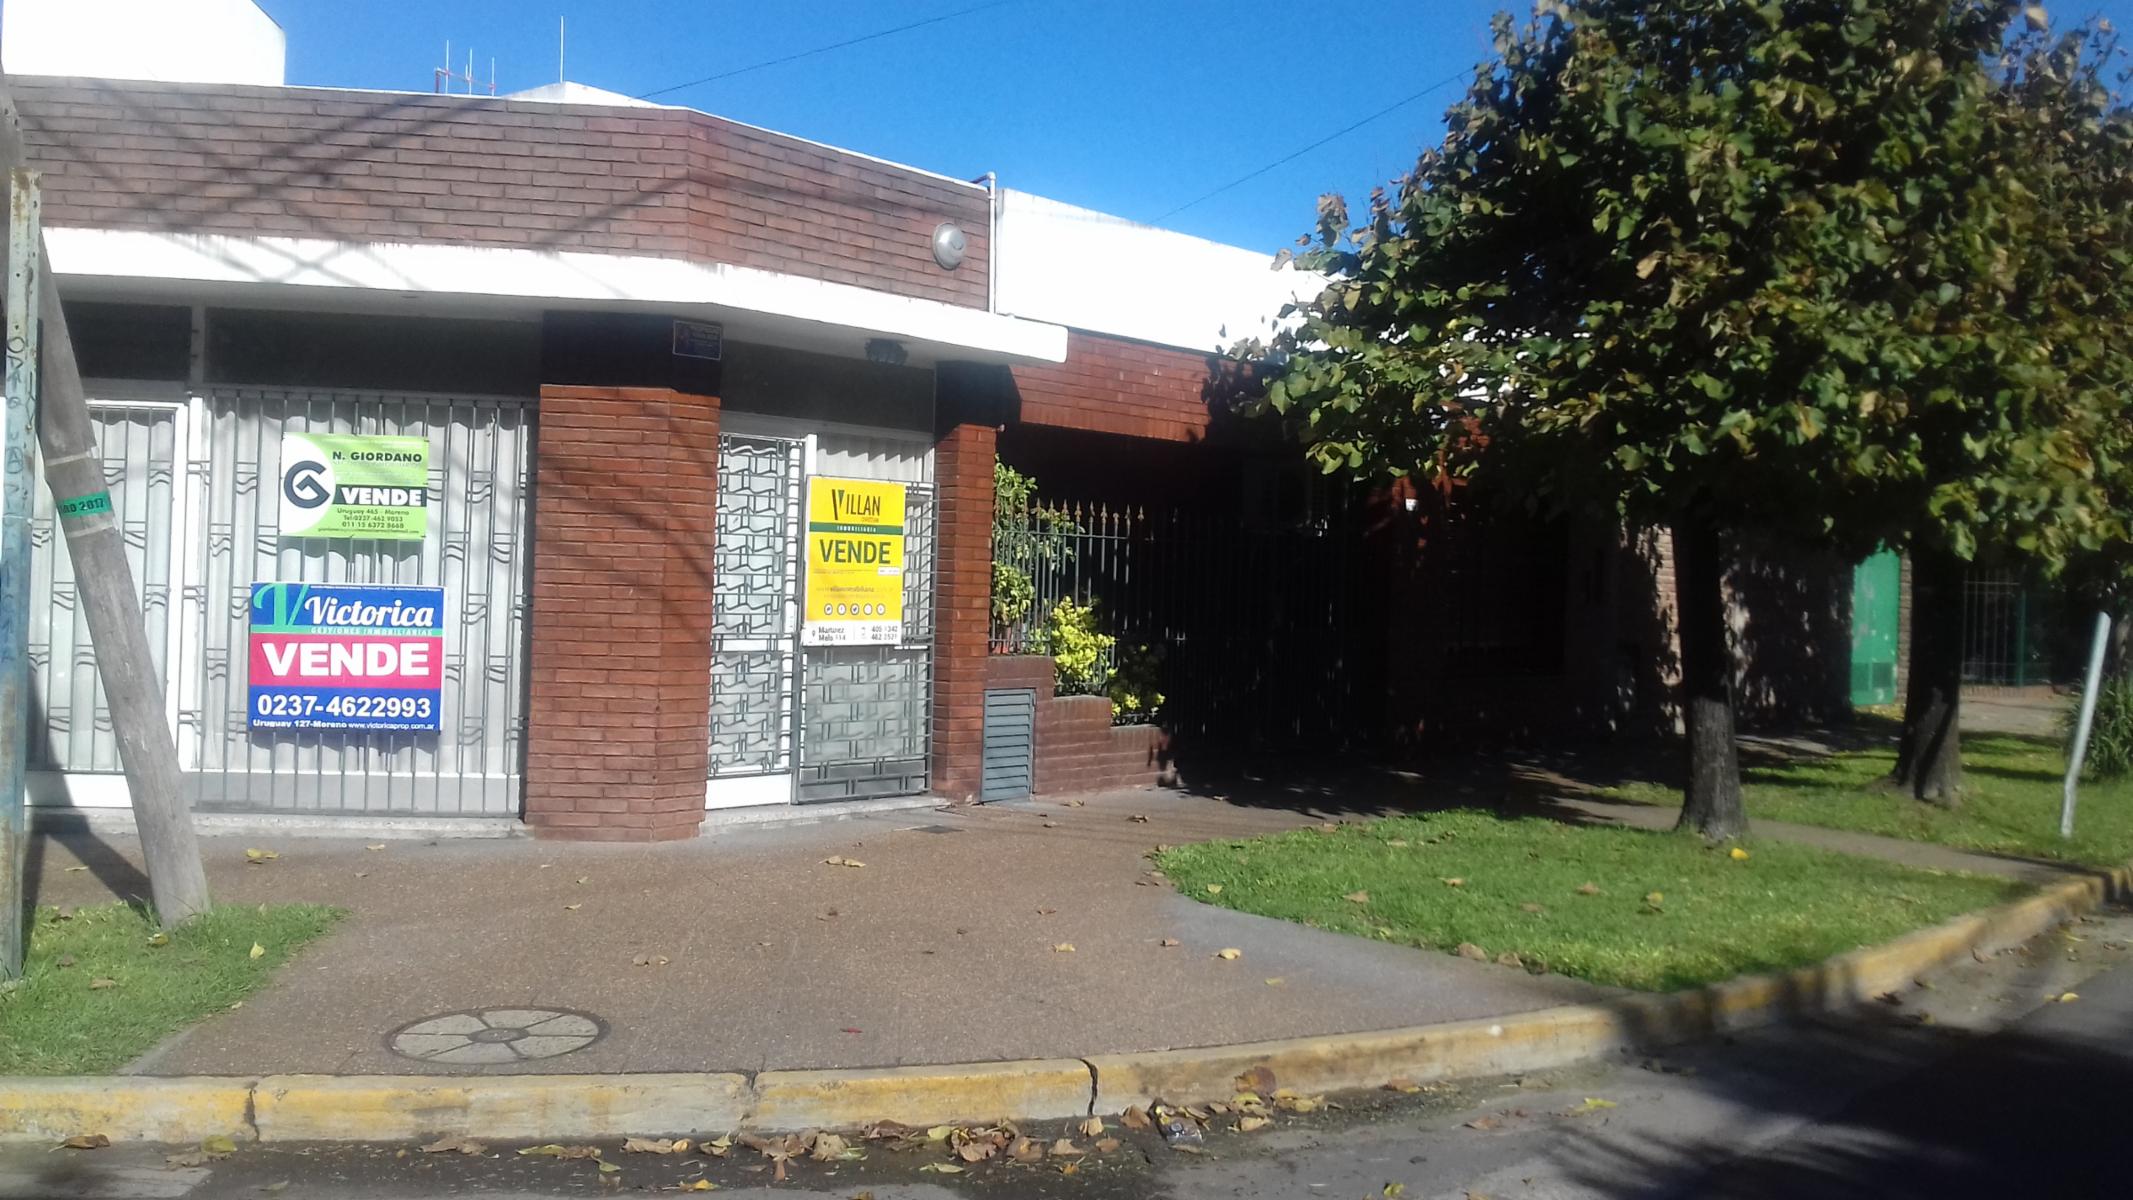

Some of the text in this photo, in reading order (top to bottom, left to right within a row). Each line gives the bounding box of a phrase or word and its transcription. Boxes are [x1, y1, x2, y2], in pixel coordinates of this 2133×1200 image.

[332, 451, 422, 463] N. GIORDANO
[340, 487, 422, 506] VENDE
[831, 489, 881, 520] VILLAN
[820, 539, 892, 565] VENDE
[304, 596, 436, 627] Victorica
[261, 643, 430, 676] VENDE
[257, 695, 431, 718] 0237-4622993
[252, 719, 292, 728] Uruguay
